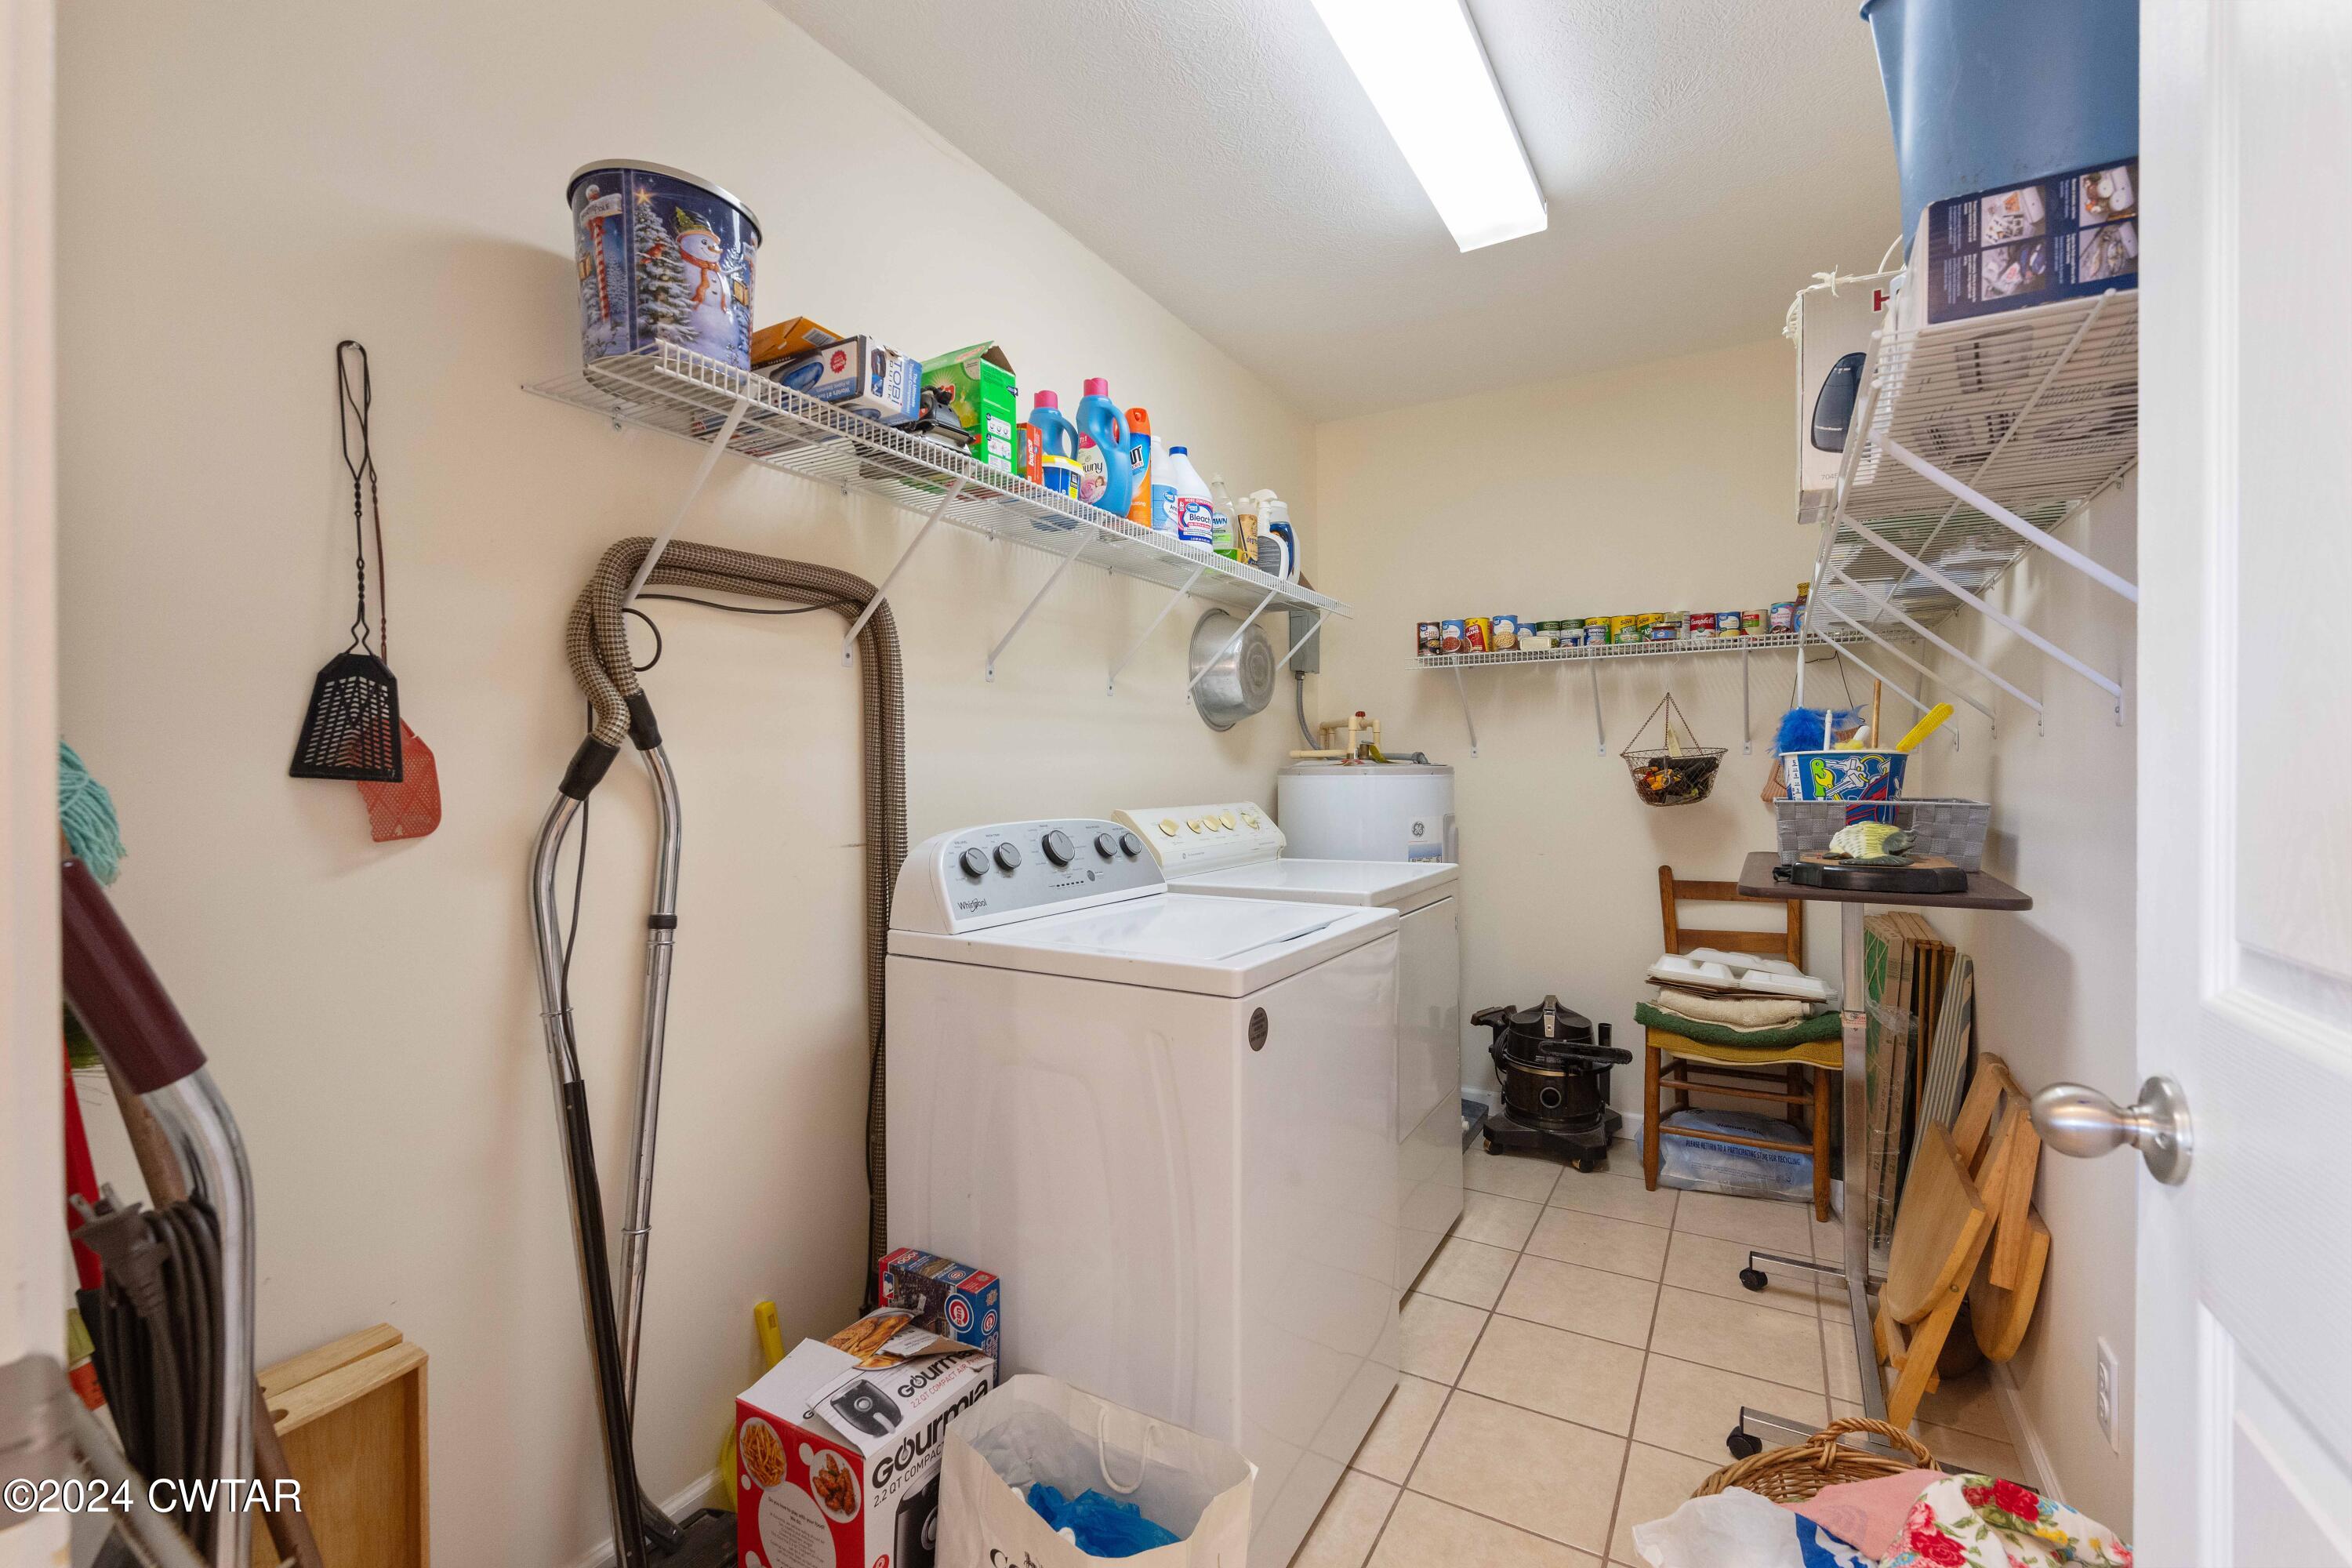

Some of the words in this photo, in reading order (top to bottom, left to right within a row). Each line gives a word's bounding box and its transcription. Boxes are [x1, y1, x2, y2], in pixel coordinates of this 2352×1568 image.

[1189, 514, 1211, 524] Bleach
[957, 898, 988, 913] Whirlpool
[1686, 1139, 1701, 1149] PLEASE
[1700, 1141, 1717, 1151] RETURN
[1717, 1143, 1724, 1152] TO
[1727, 1145, 1757, 1159] PARTICIPATING
[1777, 1155, 1801, 1166] RECYCLING
[909, 1398, 922, 1409] 2.2
[920, 1392, 930, 1402] QT
[930, 1370, 957, 1395] COMPACT
[956, 1363, 967, 1375] AIR
[873, 1489, 887, 1508] 2.2
[889, 1475, 902, 1494] QT
